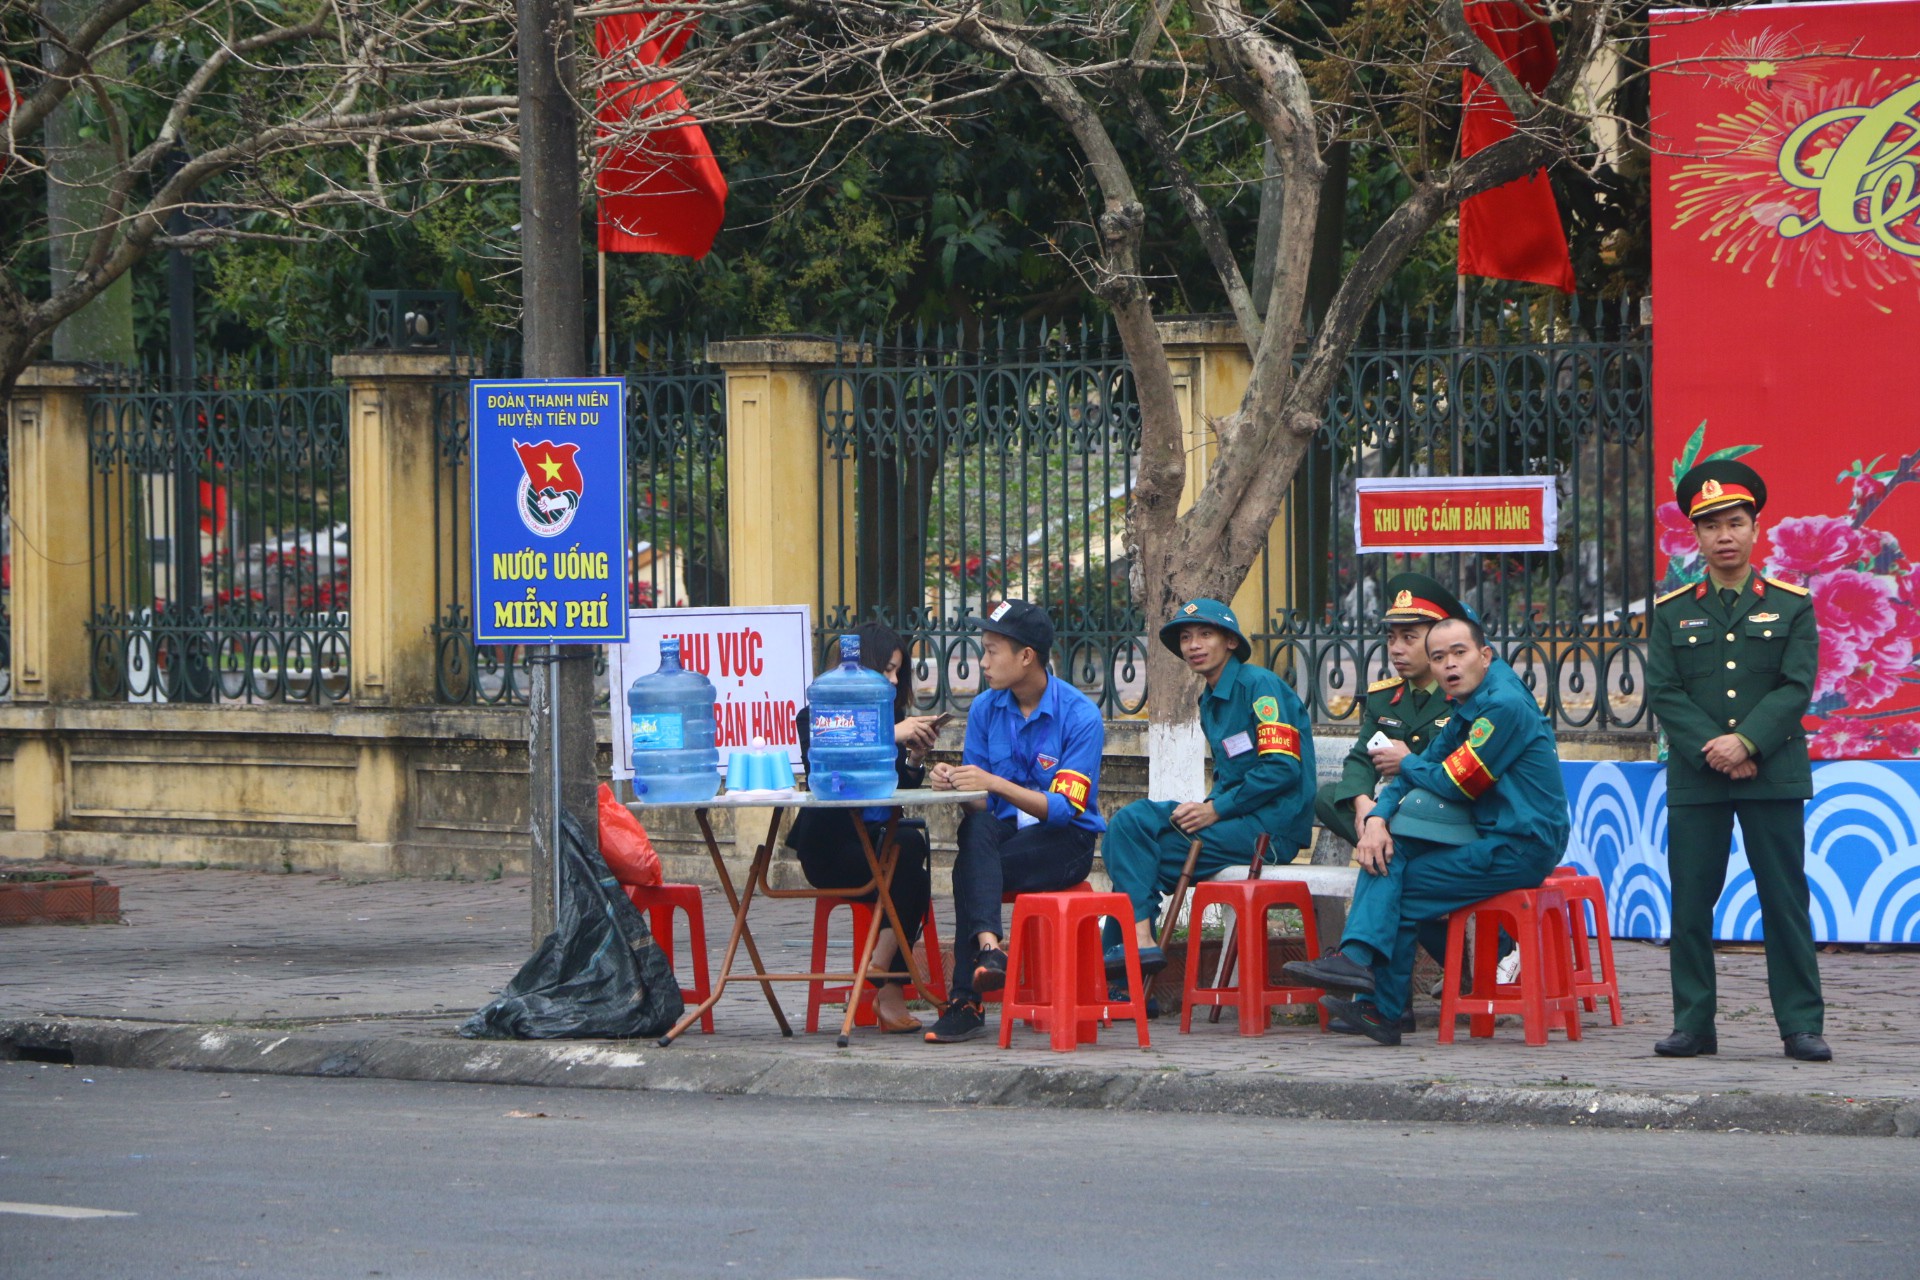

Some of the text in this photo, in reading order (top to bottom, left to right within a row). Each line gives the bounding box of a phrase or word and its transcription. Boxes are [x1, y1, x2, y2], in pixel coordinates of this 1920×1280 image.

[487, 390, 609, 408] ĐOÀN THANH NIÊN
[498, 409, 599, 428] HUYỆN TIÊN DU
[1373, 499, 1530, 536] KHU VỰC CẤM BÁN HÀNG
[493, 543, 608, 580] NƯỚC UỐNG
[494, 587, 609, 628] MIỄN PHÍ
[662, 626, 763, 687] HU VỰC
[713, 692, 747, 748] BÁN
[752, 691, 797, 747] HÀNG
